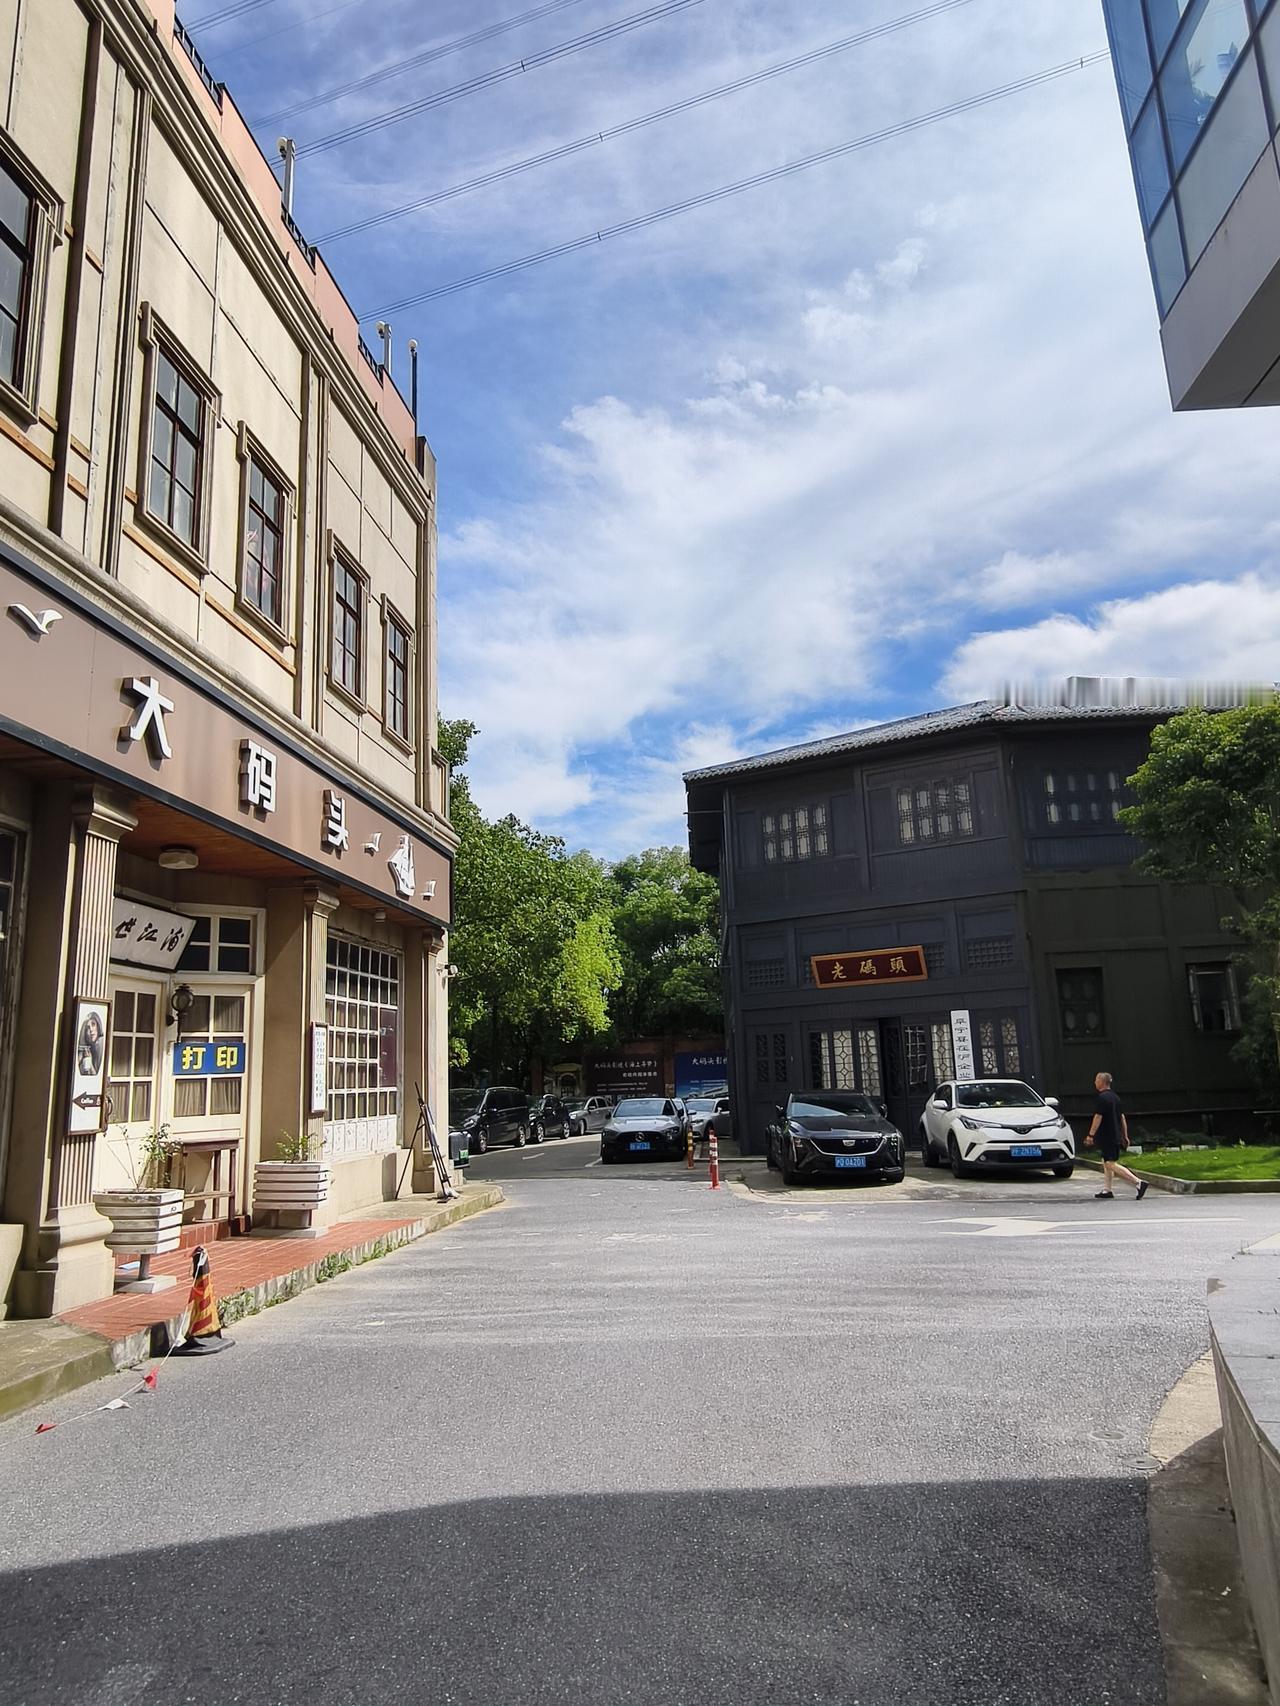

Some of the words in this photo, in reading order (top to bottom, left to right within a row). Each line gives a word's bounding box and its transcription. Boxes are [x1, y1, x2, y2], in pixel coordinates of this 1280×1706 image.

[122, 676, 349, 851] 大码头
[831, 956, 908, 980] 老碼頭
[182, 1045, 238, 1071] 打印
